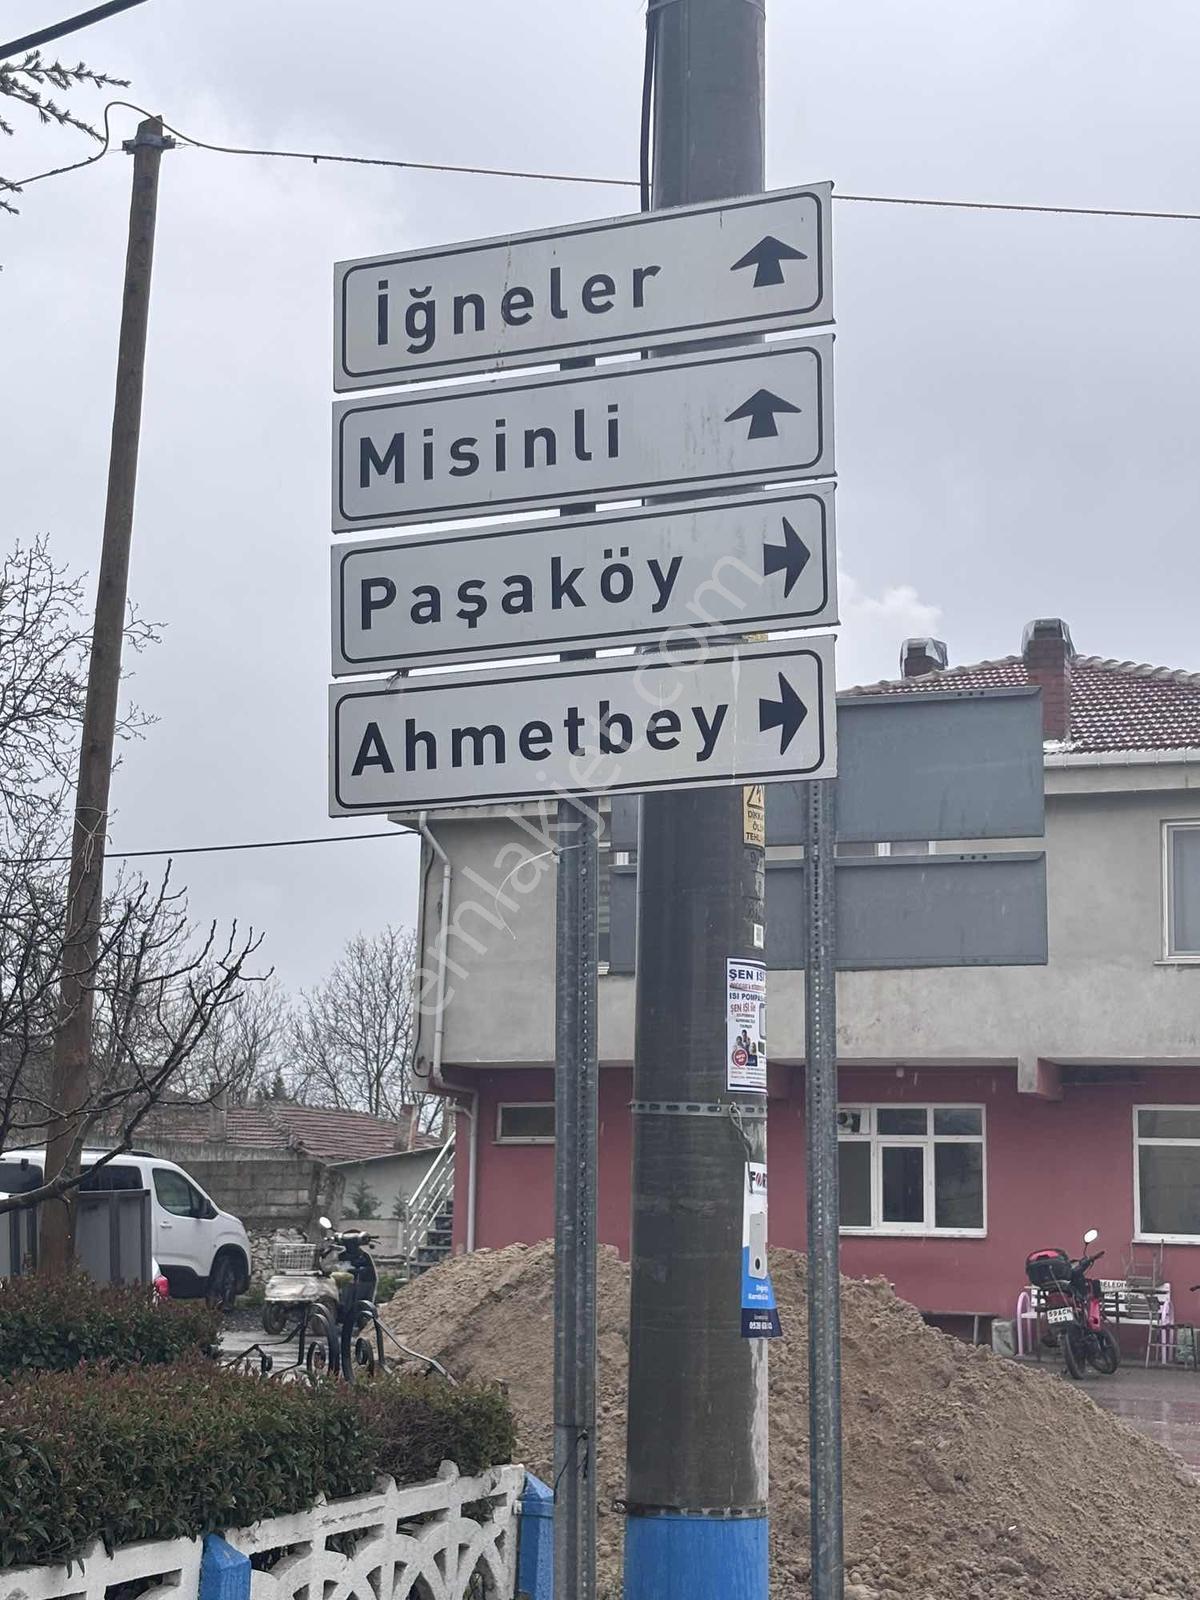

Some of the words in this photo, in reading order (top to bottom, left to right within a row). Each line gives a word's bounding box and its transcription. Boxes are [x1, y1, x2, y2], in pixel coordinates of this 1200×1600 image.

[377, 264, 662, 354] İğneler
[360, 403, 619, 488] Misinli
[360, 546, 683, 630] Paşaköy
[351, 700, 729, 777] Ahmetbey
[728, 968, 754, 981] ŞEN
